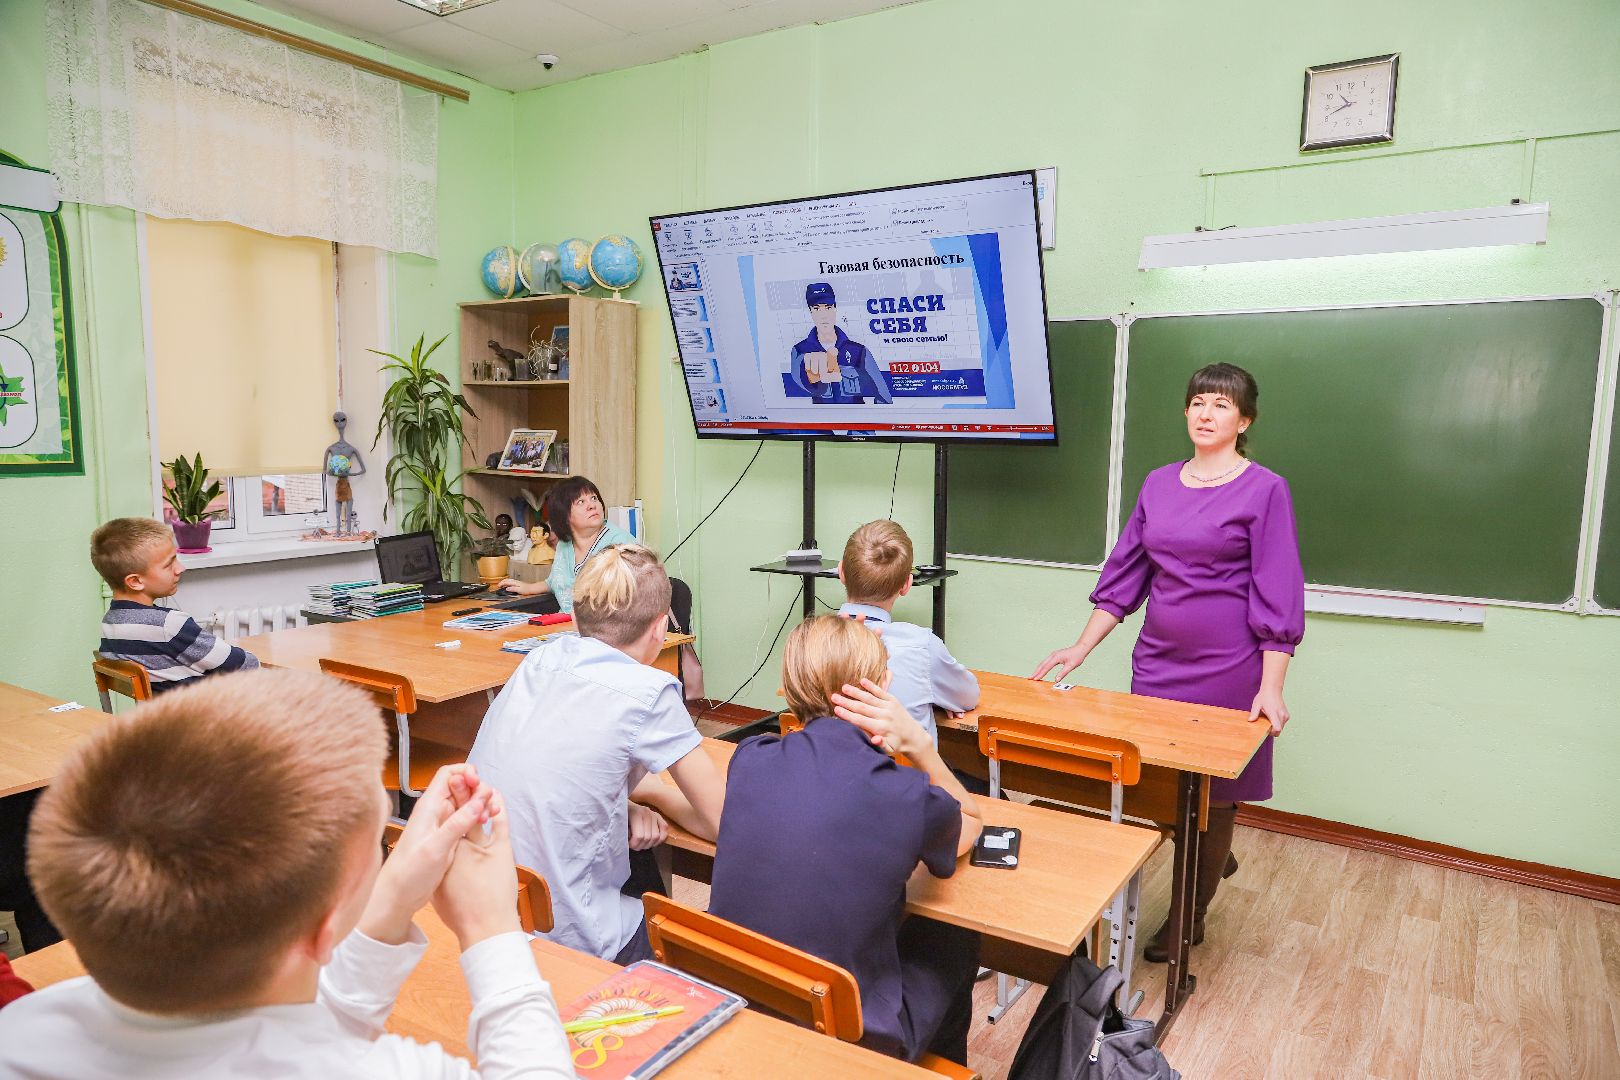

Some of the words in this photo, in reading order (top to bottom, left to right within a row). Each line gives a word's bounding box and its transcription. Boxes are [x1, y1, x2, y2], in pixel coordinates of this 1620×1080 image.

[818, 260, 870, 275] Газовая
[872, 253, 965, 271] безопасность
[866, 294, 946, 315] СПАСИ
[869, 316, 928, 335] СЕБЯ
[891, 336, 914, 344] свою
[915, 334, 948, 344] семью!
[891, 363, 910, 373] 112
[919, 362, 939, 373] 104
[572, 1033, 624, 1069] 8
